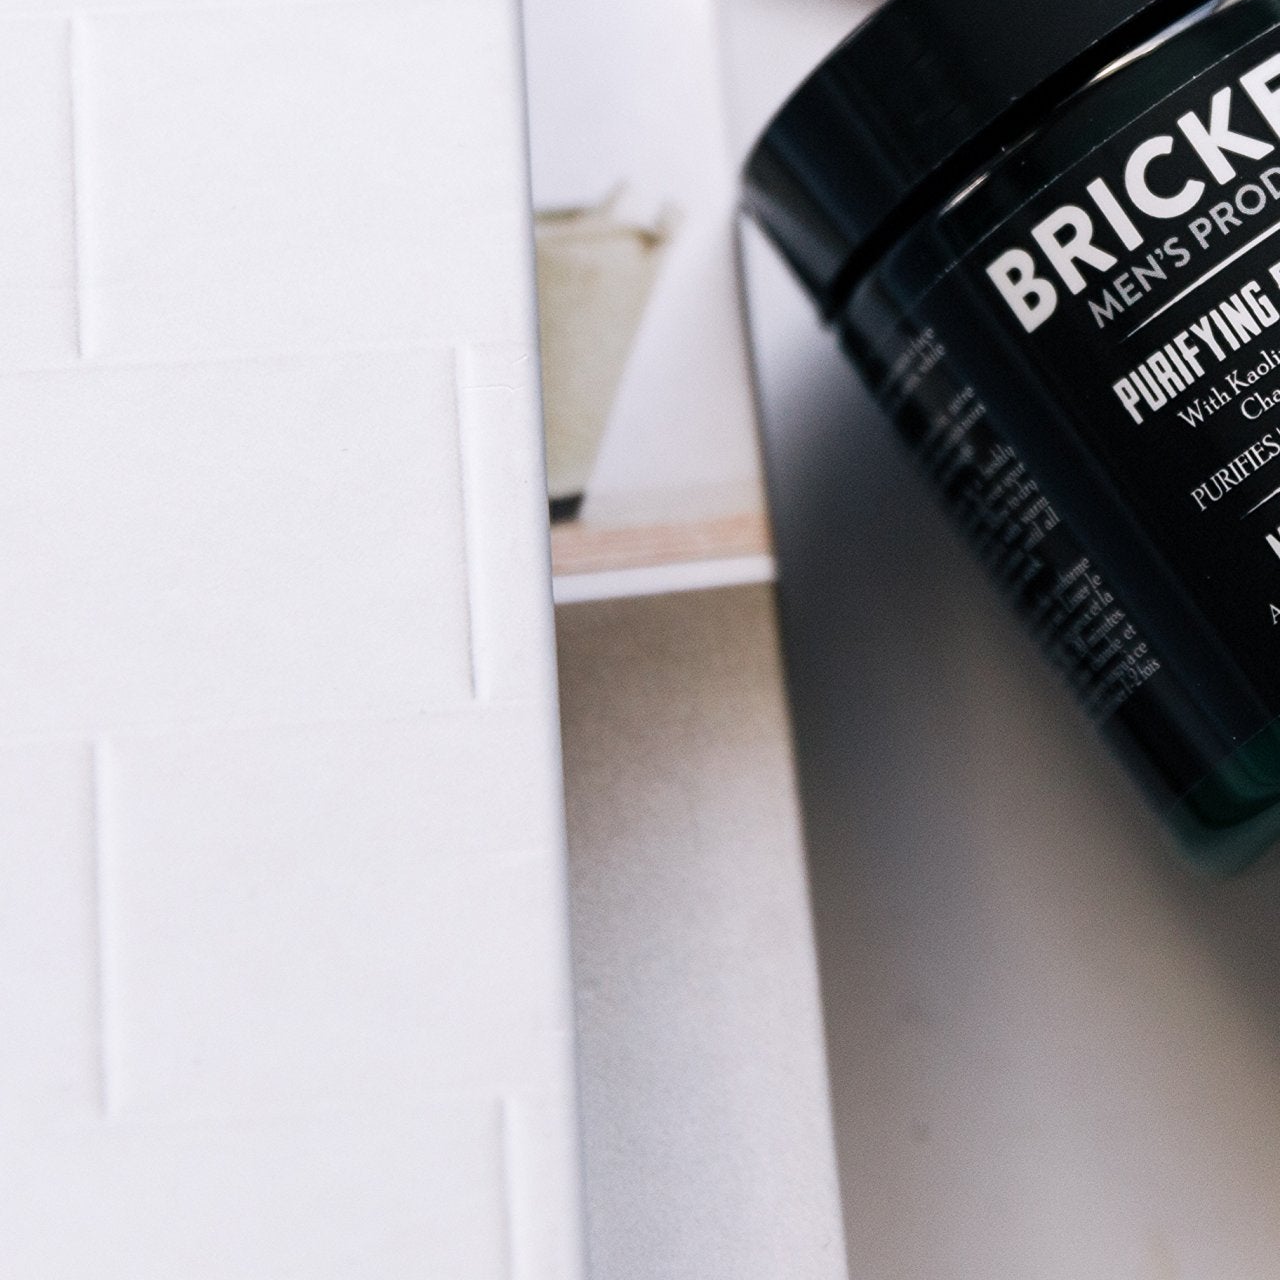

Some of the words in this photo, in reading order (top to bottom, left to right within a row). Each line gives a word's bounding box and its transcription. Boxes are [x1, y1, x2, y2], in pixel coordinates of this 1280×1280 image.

[1087, 235, 1191, 329] MEN'S
[1112, 280, 1280, 426] PURIFYING
[1177, 387, 1232, 429] With
